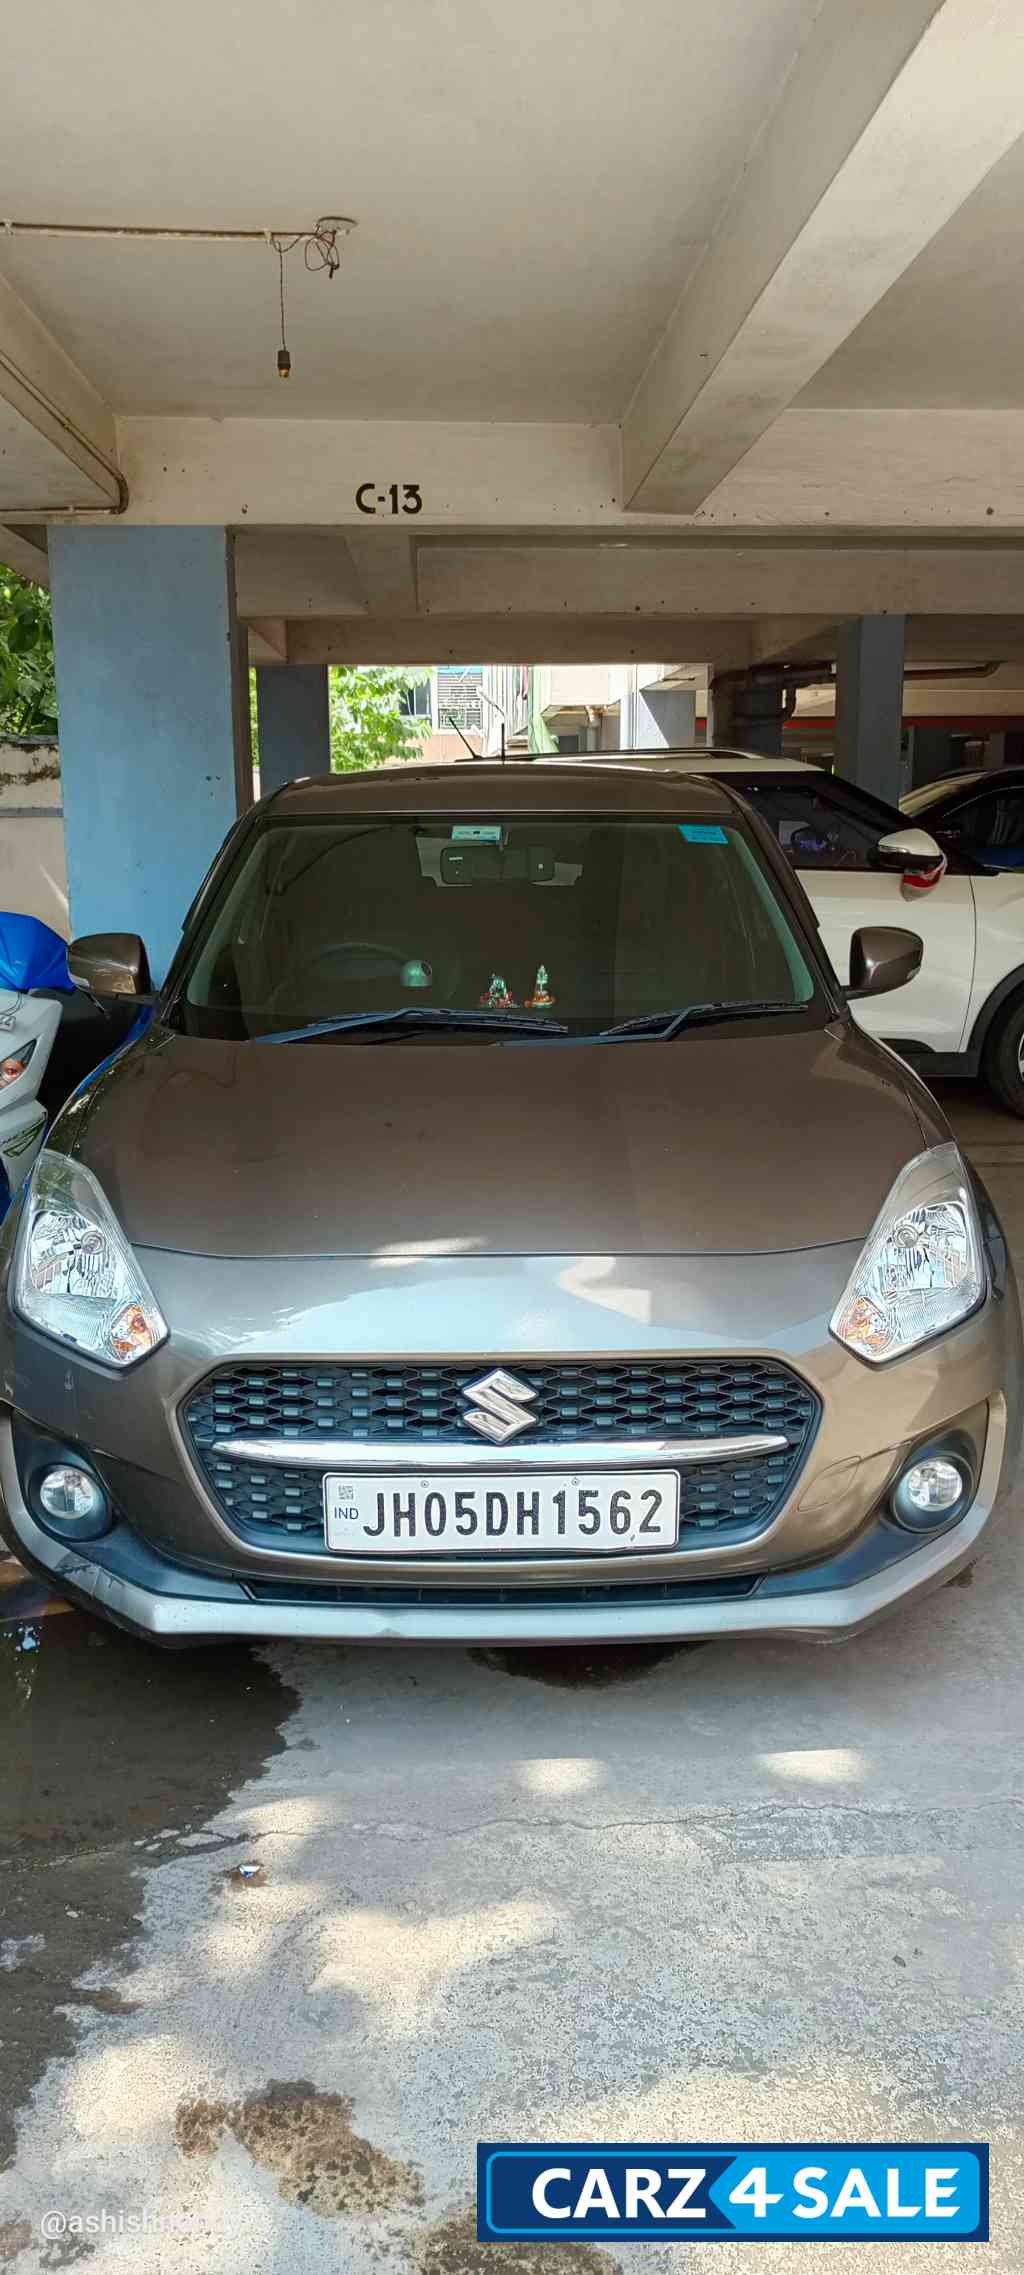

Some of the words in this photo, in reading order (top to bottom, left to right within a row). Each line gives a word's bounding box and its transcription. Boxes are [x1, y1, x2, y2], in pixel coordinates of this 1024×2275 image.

[355, 483, 422, 514] C-13
[334, 1507, 359, 1520] IND
[363, 1489, 662, 1537] JH05DH1562
